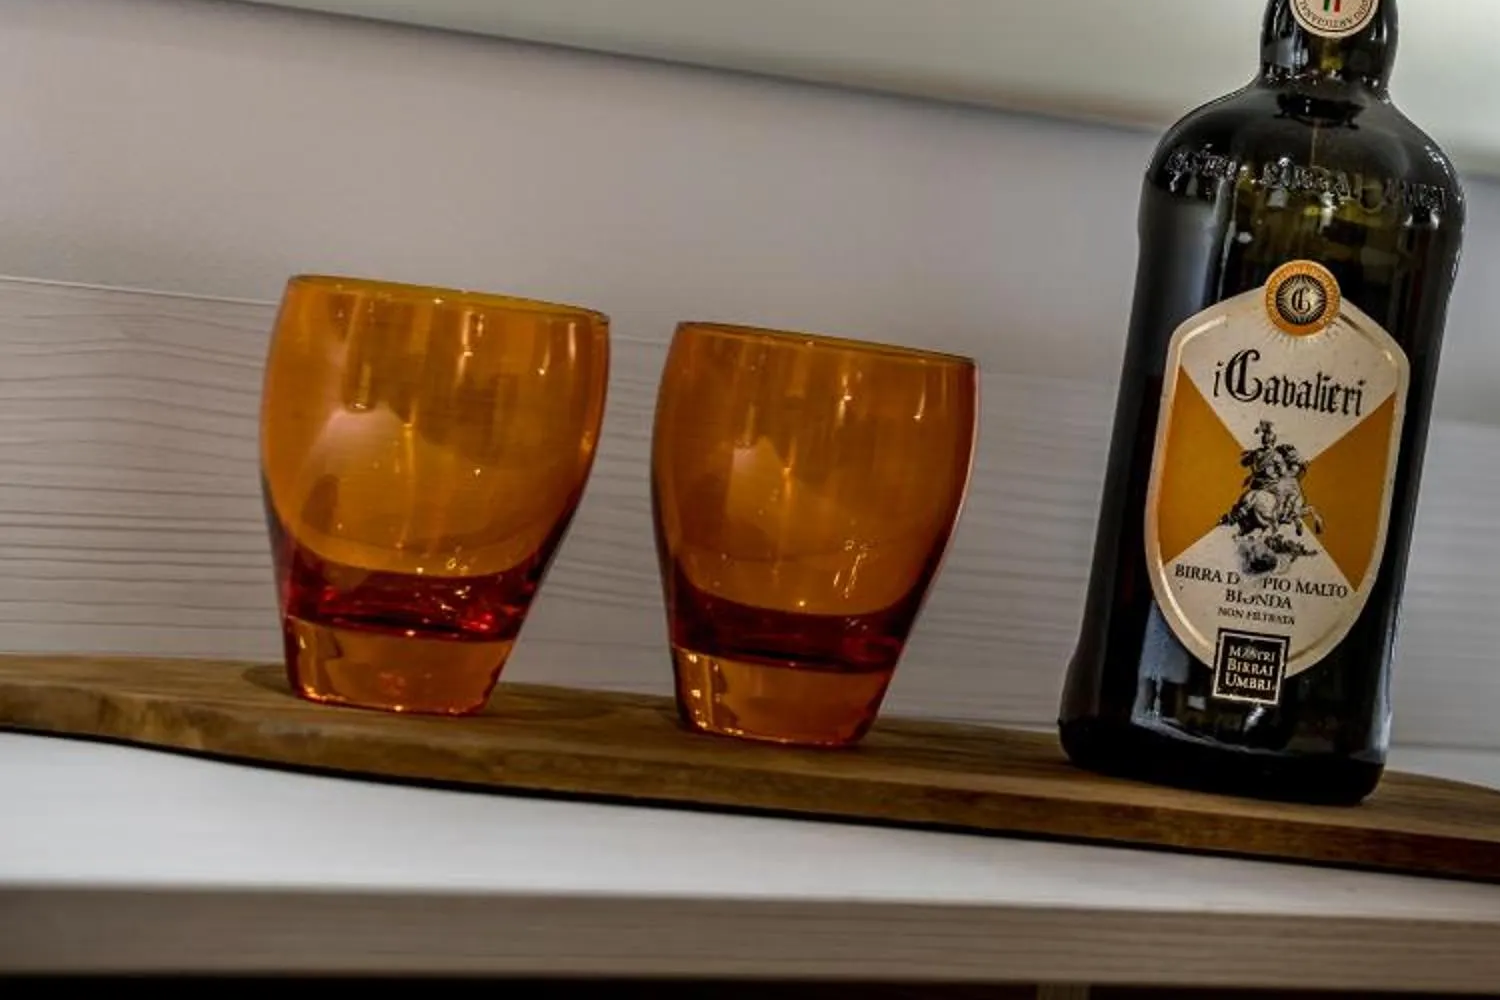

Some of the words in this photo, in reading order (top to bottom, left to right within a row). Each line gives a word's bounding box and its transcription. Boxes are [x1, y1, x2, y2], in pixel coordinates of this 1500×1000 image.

[1174, 563, 1222, 583] BIRRA
[1226, 571, 1291, 593] DPIO
[1295, 581, 1348, 599] MALTO
[1217, 606, 1244, 619] NON
[1245, 610, 1295, 625] FILTRATA
